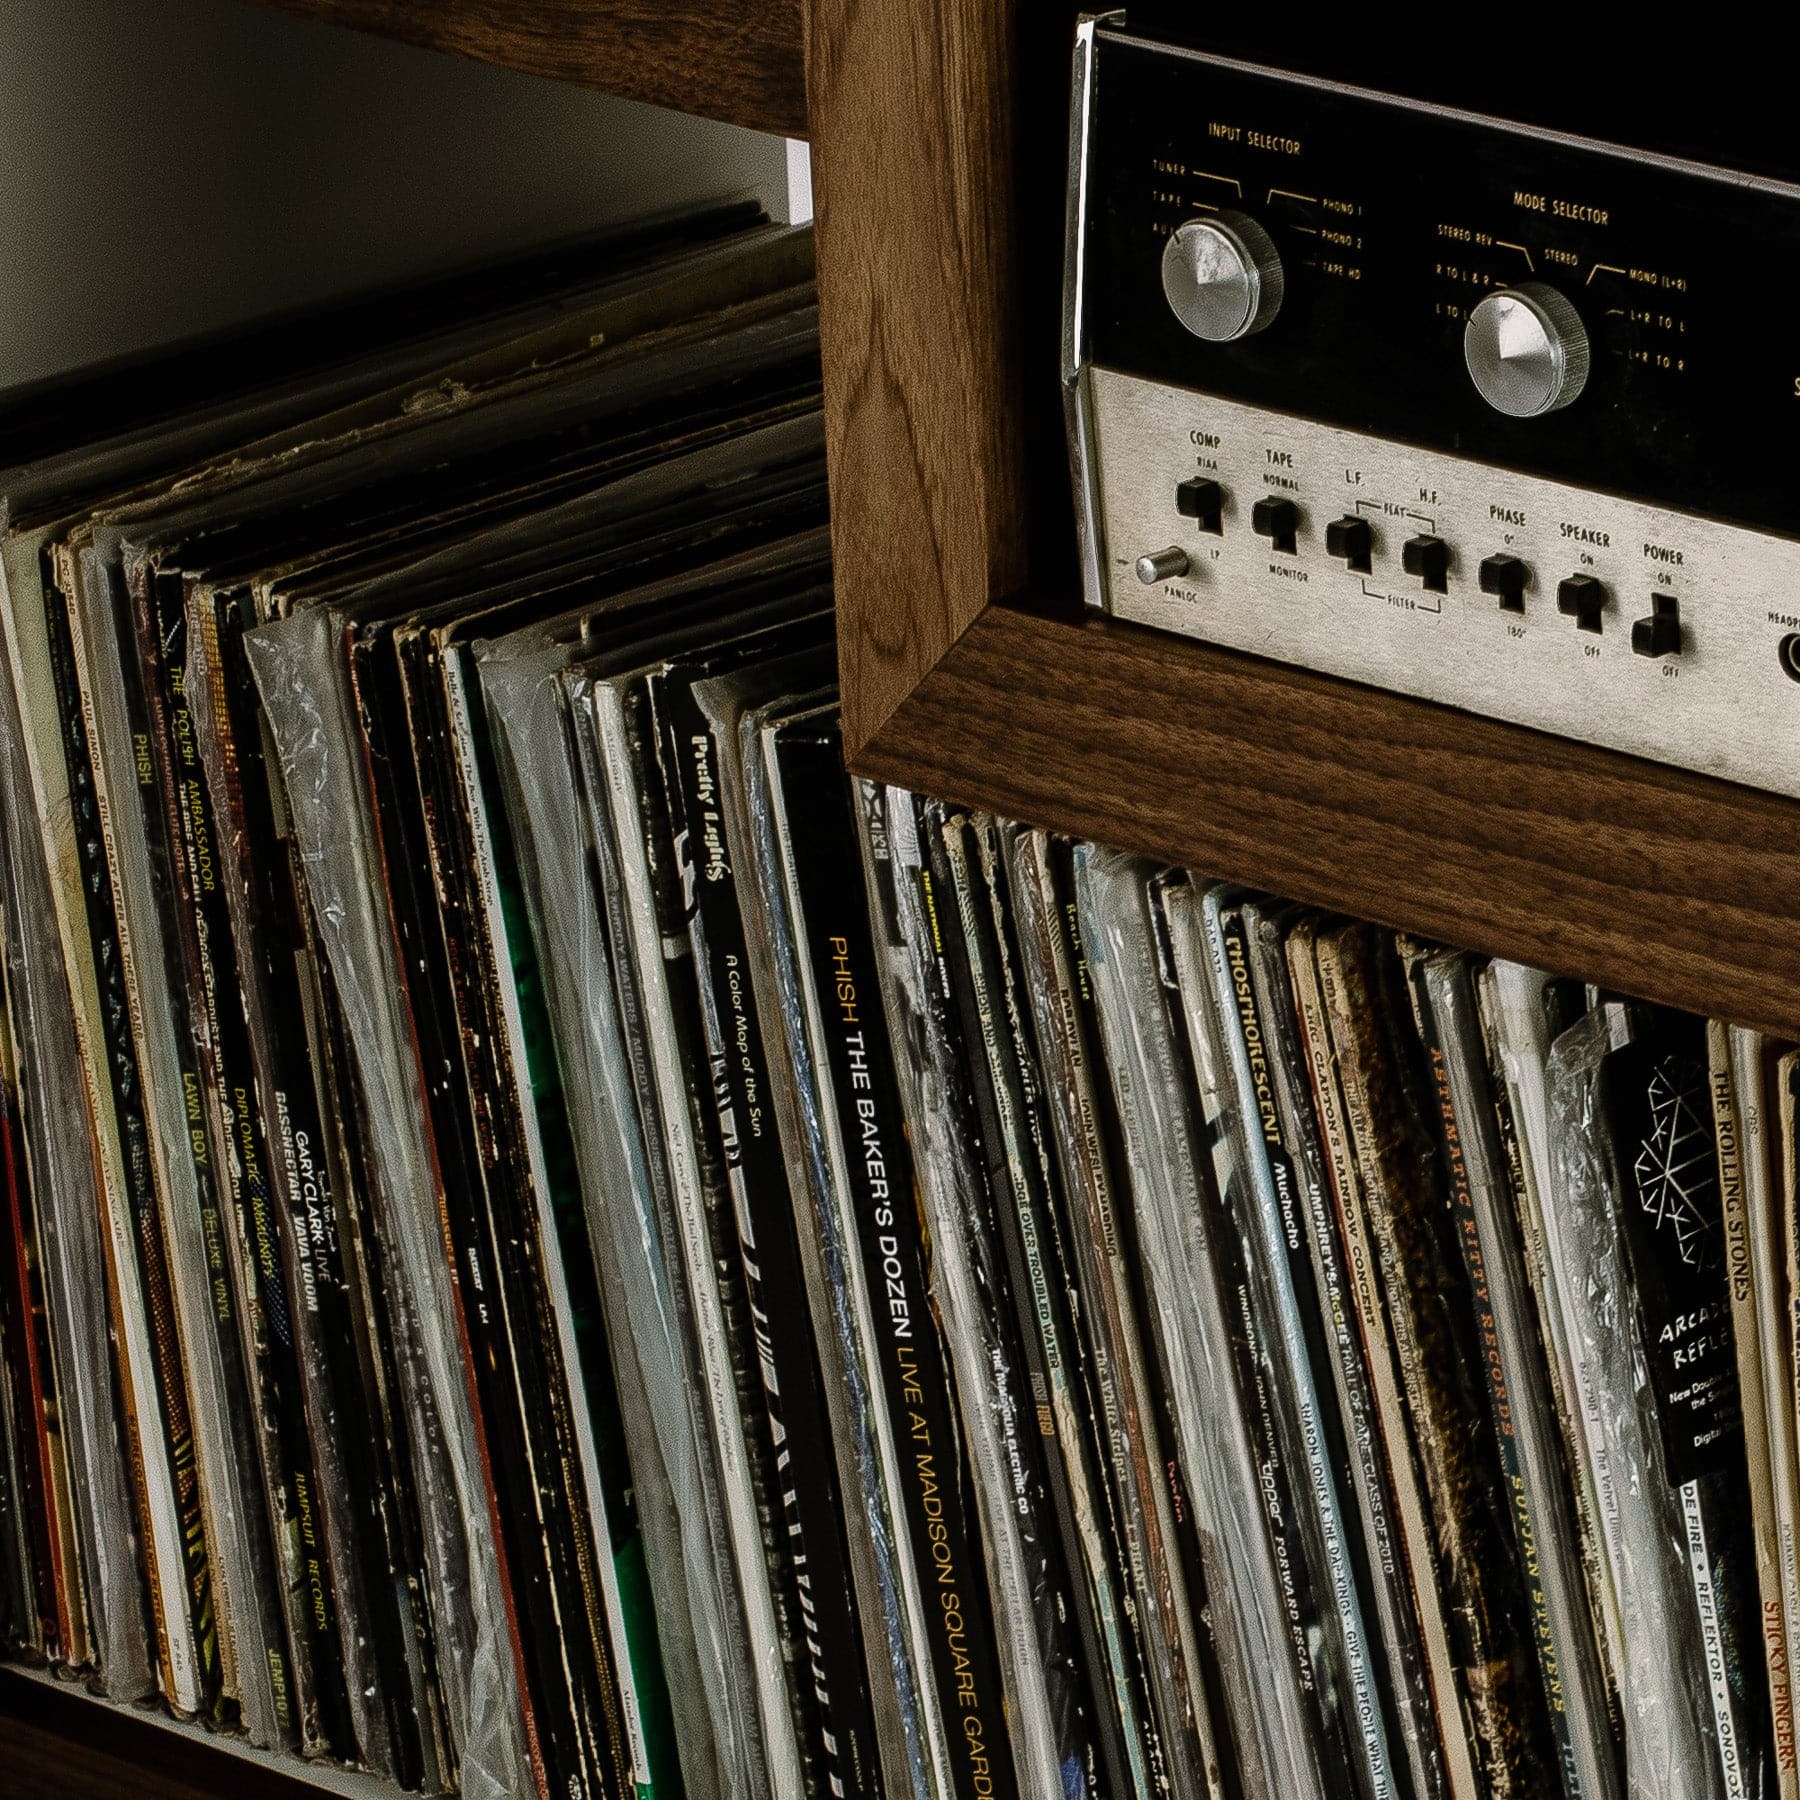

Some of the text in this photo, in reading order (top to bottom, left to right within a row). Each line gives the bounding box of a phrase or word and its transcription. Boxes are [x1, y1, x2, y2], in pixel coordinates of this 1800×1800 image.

[1208, 122, 1301, 155] INPUT SELECTOR
[1513, 191, 1609, 226] MODE SELECTOR
[1190, 430, 1220, 449] COMP
[1266, 449, 1294, 468] TAPE
[1263, 473, 1299, 491] NORMAL
[1345, 469, 1365, 487] L.F.
[1419, 487, 1442, 507] H.F.
[1489, 505, 1527, 527] PHASE
[1559, 522, 1610, 549] SPEAKER
[1268, 564, 1309, 582] MONITOR
[1580, 552, 1594, 566] ON
[1643, 543, 1685, 567] POWER
[1658, 571, 1672, 586] ON
[1387, 594, 1416, 610] FILTER
[1662, 664, 1679, 679] OFF
[133, 732, 152, 785] PHISH
[168, 665, 185, 696] THE
[186, 777, 215, 892] AMBASSADOR
[725, 953, 763, 1137] A Color Map of the Sun
[181, 1071, 208, 1165] LAWN BOY
[1224, 935, 1302, 1249] PHOSPHORESCENT Muchacho
[828, 934, 913, 1340] PHISH THE BAKER'S DOZEN
[274, 1089, 319, 1314] BASSNECTAR VAVA VOOM
[295, 1130, 315, 1183] GARY
[313, 1247, 331, 1284] LIVE
[1712, 1070, 1751, 1302] THE ROLLING STONES
[202, 1206, 231, 1322] DELUXE VINYL
[1332, 1152, 1359, 1238] RAINBOW
[1351, 1245, 1377, 1328] CONCERT
[1429, 1046, 1515, 1438] ASTHMATIC KITTY RECORDS
[896, 1344, 923, 1406] LIVE
[907, 1409, 930, 1448] AT
[1036, 1402, 1055, 1436] FUEGO
[915, 1452, 955, 1585] MADISON
[293, 1470, 328, 1631] JUMPSUIT RECORDS
[1273, 1534, 1301, 1621] FORWARD
[1291, 1623, 1315, 1692] ESCAPE
[1509, 1473, 1541, 1578] SUFJAN
[1530, 1587, 1567, 1715] STEVENS
[939, 1591, 977, 1710] SQUARE
[1686, 1513, 1703, 1554] FIRE
[1697, 1580, 1723, 1683] REFLEKTOR
[1716, 1708, 1741, 1799] SONOVOX
[1763, 1600, 1796, 1771] STICKY FINGERS
